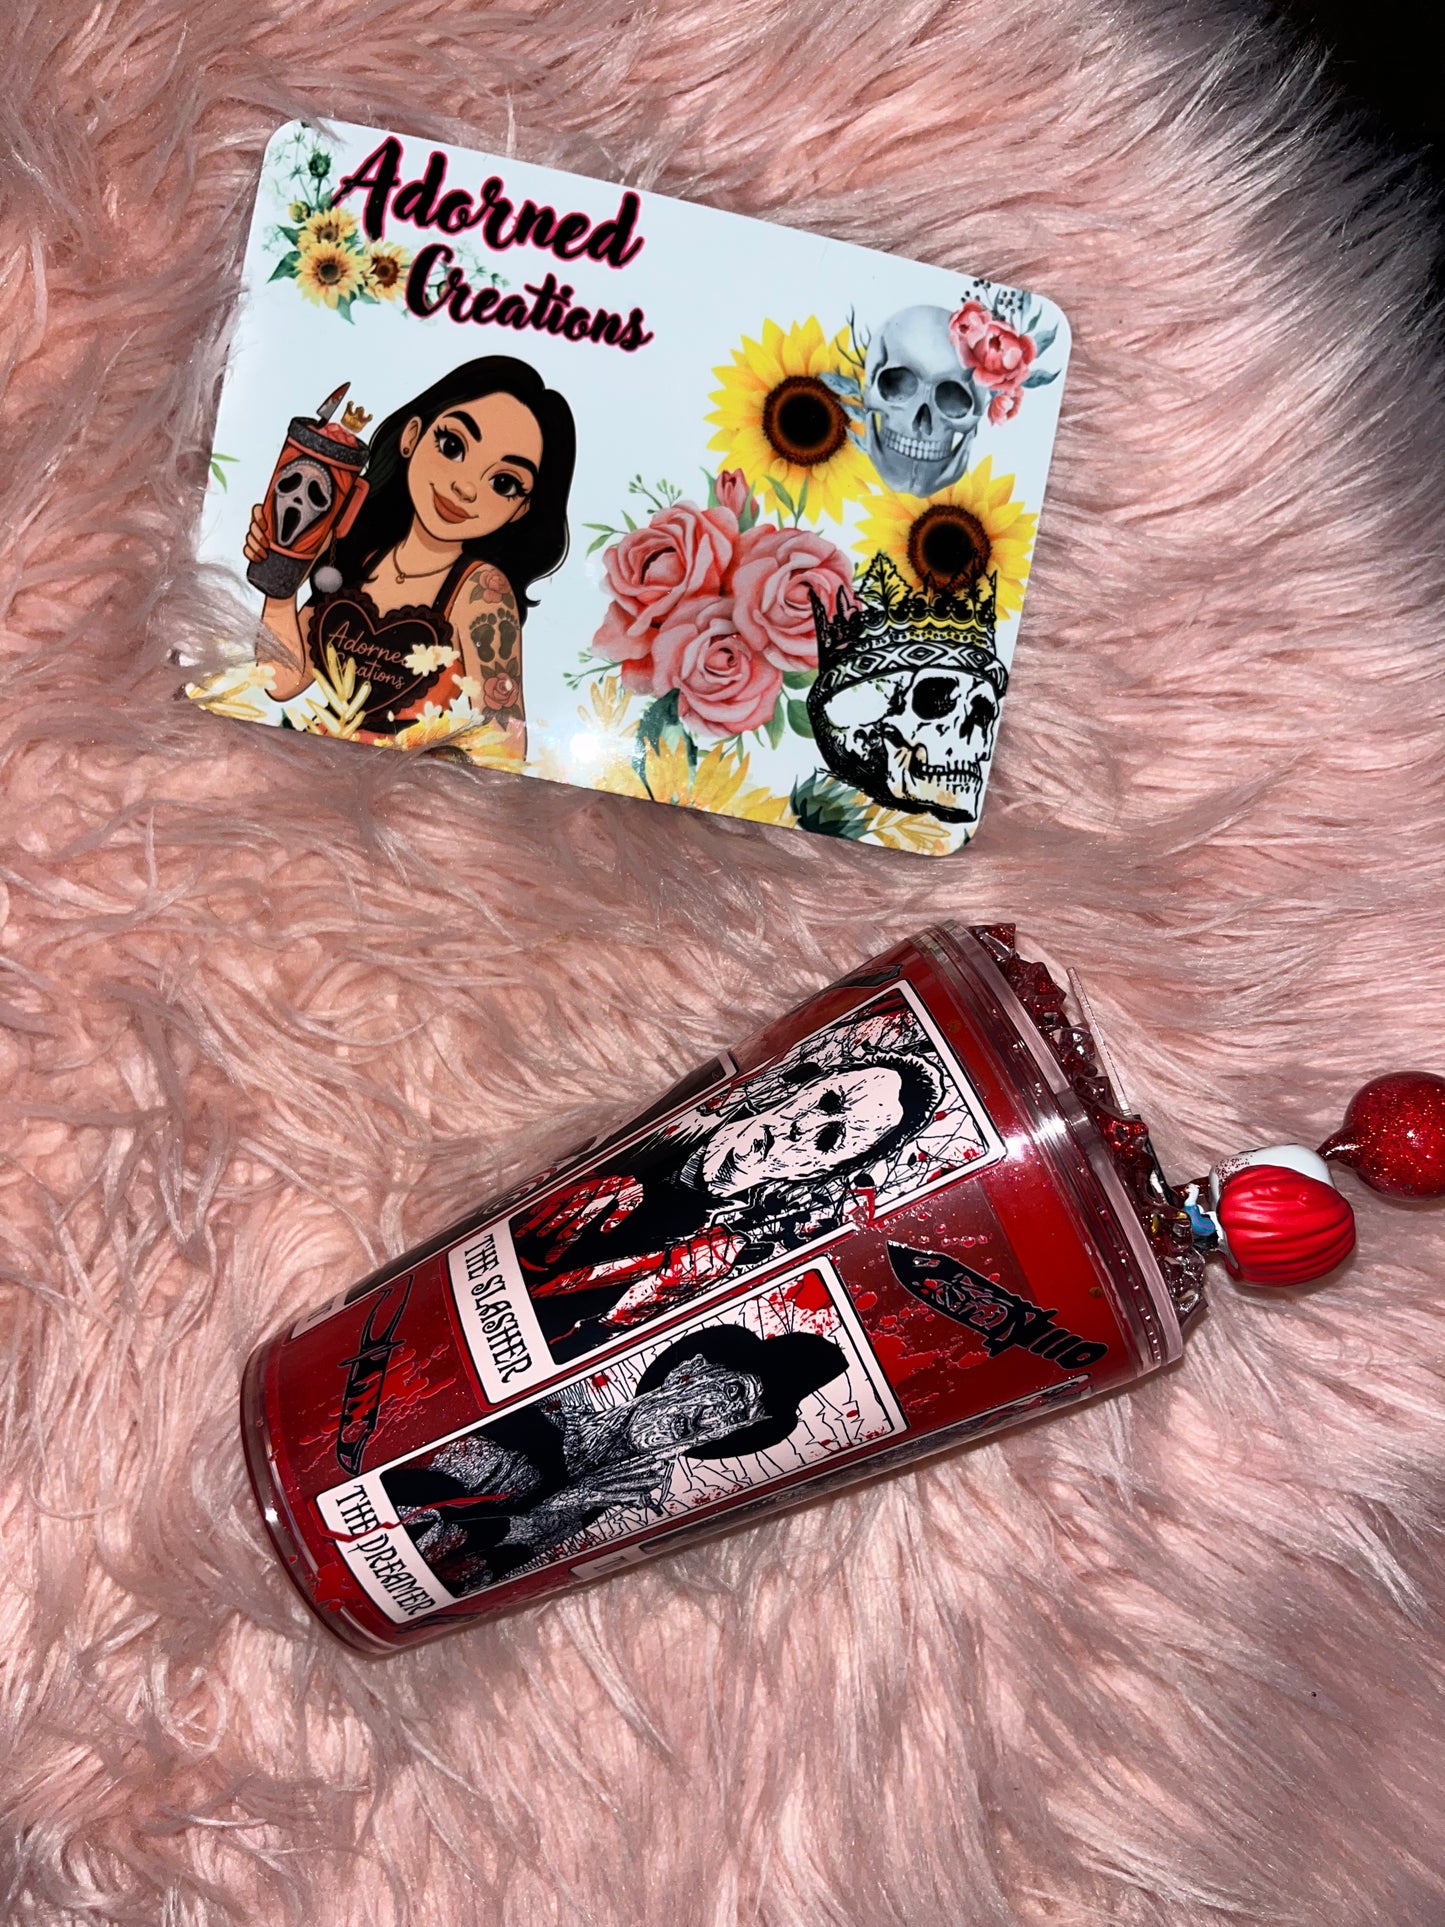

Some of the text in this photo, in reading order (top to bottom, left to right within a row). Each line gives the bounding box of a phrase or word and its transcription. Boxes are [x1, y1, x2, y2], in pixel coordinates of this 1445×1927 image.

[331, 136, 645, 269] Adorned
[405, 243, 654, 352] Creations
[328, 620, 408, 665] Adorne
[336, 652, 406, 690] ations
[464, 1233, 532, 1383] THE SLASHER
[335, 1484, 436, 1616] THE DREAMER
